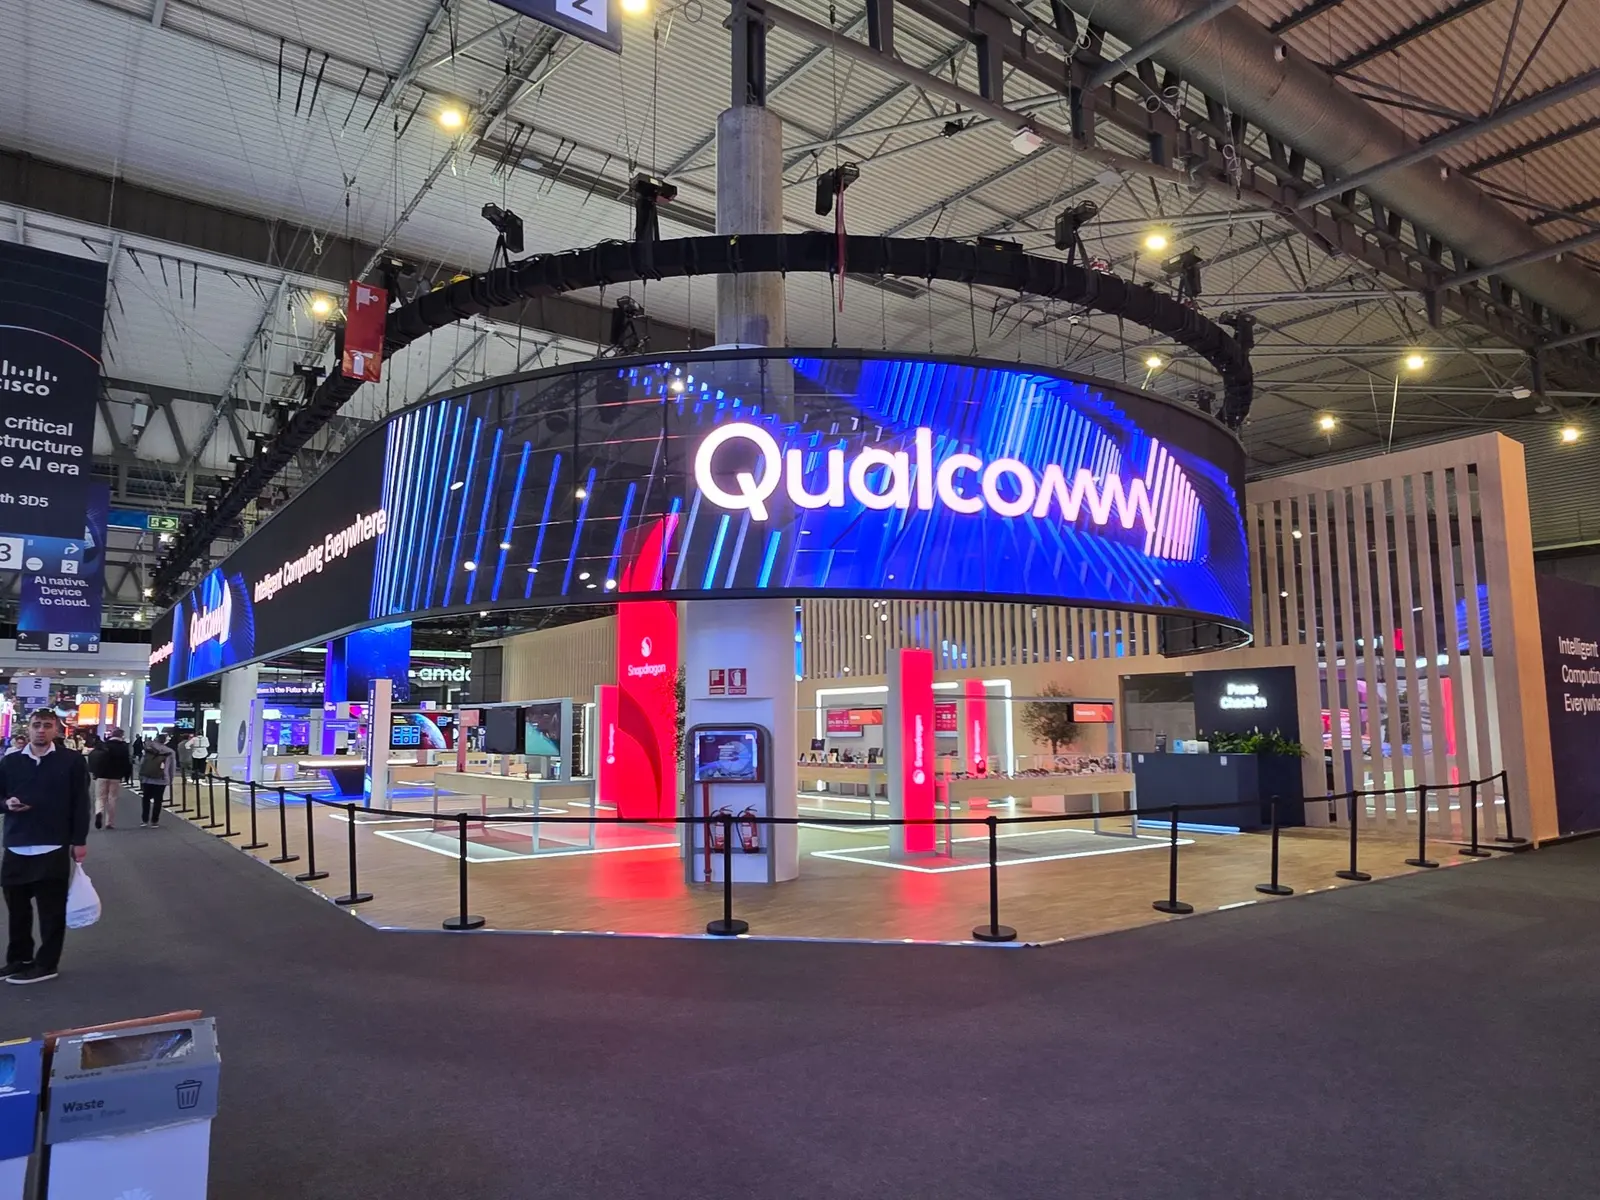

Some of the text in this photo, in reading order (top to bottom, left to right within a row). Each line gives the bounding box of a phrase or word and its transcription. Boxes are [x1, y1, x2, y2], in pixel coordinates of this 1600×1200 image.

[0, 379, 50, 396] ISCO
[5, 416, 73, 436] critical
[0, 434, 83, 457] tructure
[19, 456, 41, 470] AI
[47, 461, 79, 476] era
[695, 422, 1156, 533] Qualcomm
[18, 495, 48, 507] 3D5
[254, 508, 386, 603] Intelligent Computing Everywhere
[65, 562, 73, 571] 2
[34, 576, 88, 587] AI native.
[41, 586, 82, 596] Device
[39, 597, 90, 607] to cloud.
[54, 636, 64, 648] 3
[1558, 635, 1599, 660] Intelligent
[627, 664, 666, 677] Snapdragon
[62, 1099, 105, 1114] Waste
